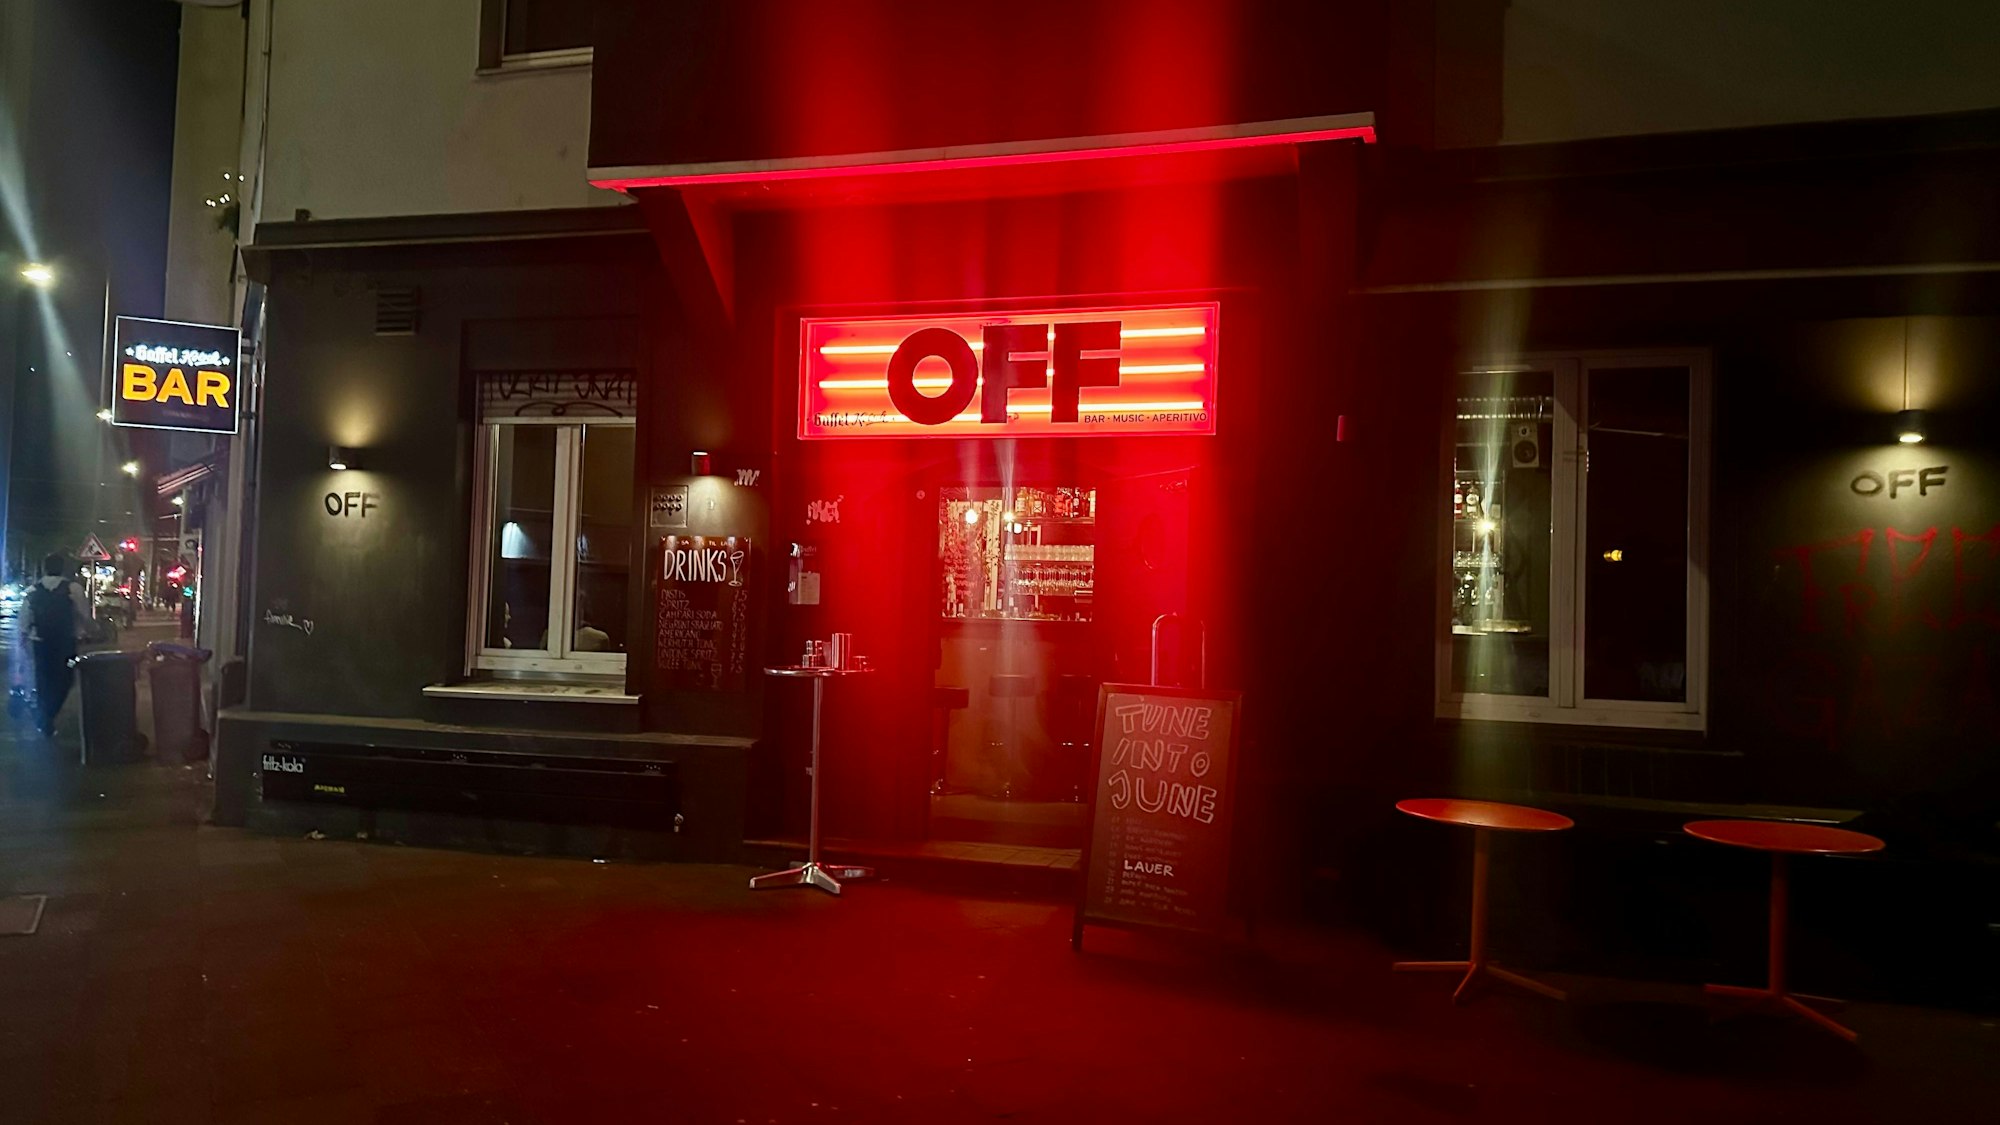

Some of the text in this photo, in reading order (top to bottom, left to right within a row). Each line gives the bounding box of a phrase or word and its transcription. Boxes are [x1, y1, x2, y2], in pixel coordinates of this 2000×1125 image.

[122, 363, 231, 409] BAR
[887, 320, 1122, 425] OFF
[1084, 412, 1208, 424] BAR MUSIC APERITIVO
[1850, 466, 1950, 499] OFF
[324, 491, 381, 518] OFF
[663, 548, 727, 583] DRINKS
[1115, 699, 1212, 740] TUNE
[262, 753, 305, 774] fritz-kola
[1111, 737, 1211, 778] INTO
[1108, 769, 1218, 824] JUNE
[1124, 859, 1174, 877] LAUER
